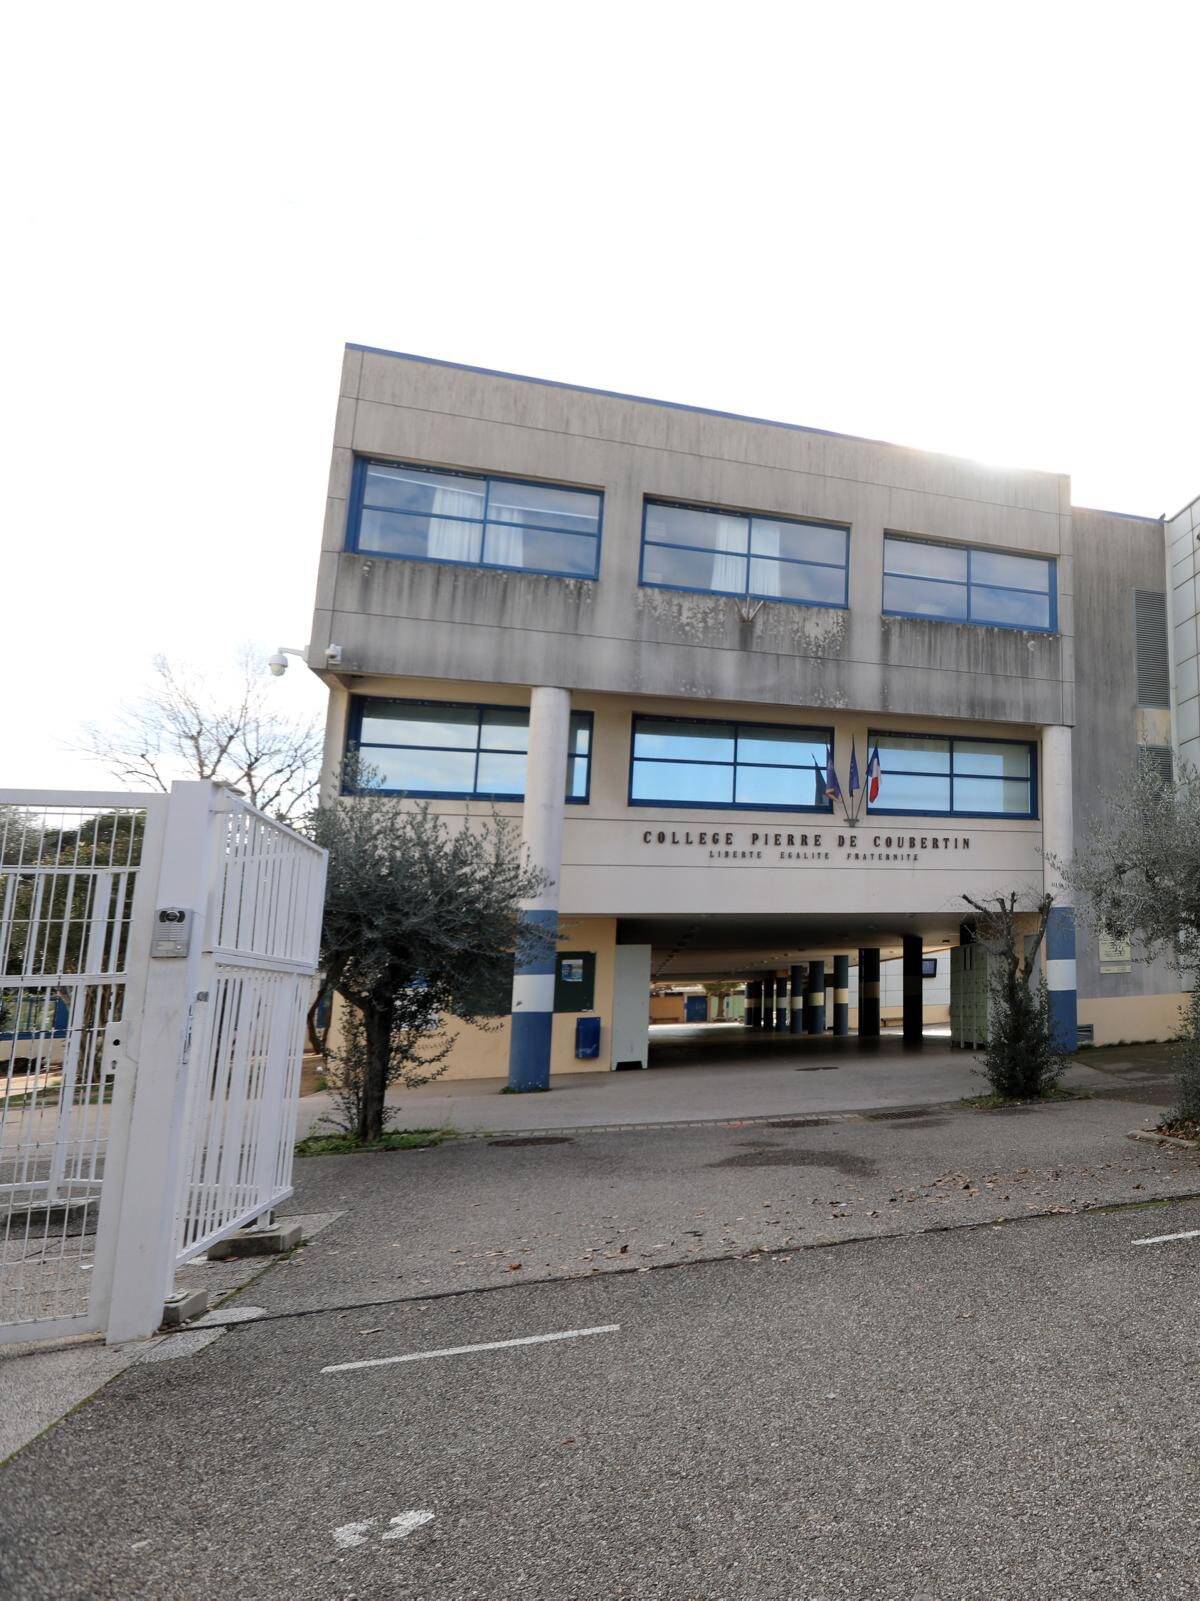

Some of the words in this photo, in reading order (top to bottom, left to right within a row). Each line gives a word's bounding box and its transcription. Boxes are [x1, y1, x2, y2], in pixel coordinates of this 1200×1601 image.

[643, 831, 734, 845] COLLEGE
[752, 833, 822, 847] PIERRE
[837, 835, 857, 847] DE
[873, 836, 971, 850] COUBERTIN
[709, 850, 763, 859] LIBERTE
[780, 851, 830, 860] EGALITE
[846, 853, 920, 861] FRATERNITE
